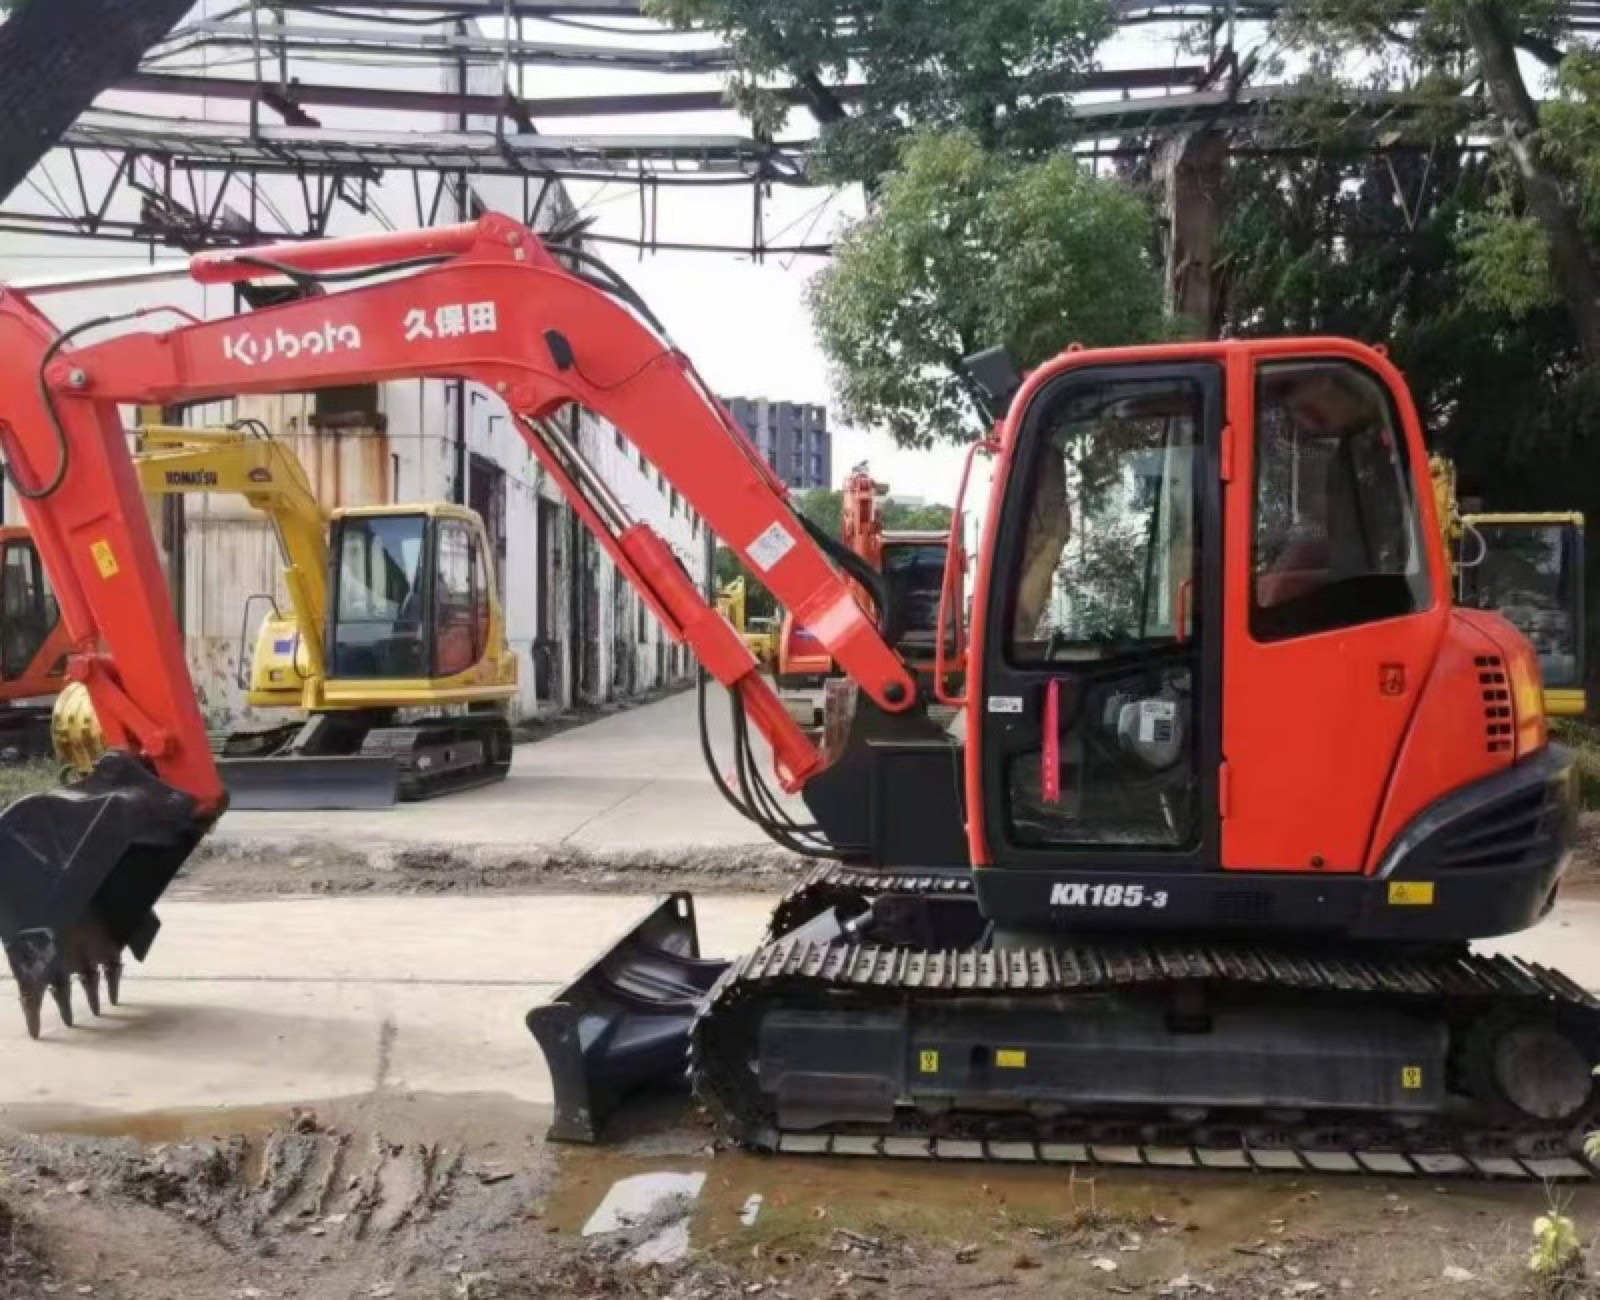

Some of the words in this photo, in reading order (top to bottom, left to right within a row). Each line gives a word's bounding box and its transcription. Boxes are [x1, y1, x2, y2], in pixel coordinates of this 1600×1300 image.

[403, 301, 497, 341] 久保田
[223, 320, 361, 365] Kubota
[165, 469, 218, 485] KOMATSU
[1049, 882, 1169, 908] KX185-3
